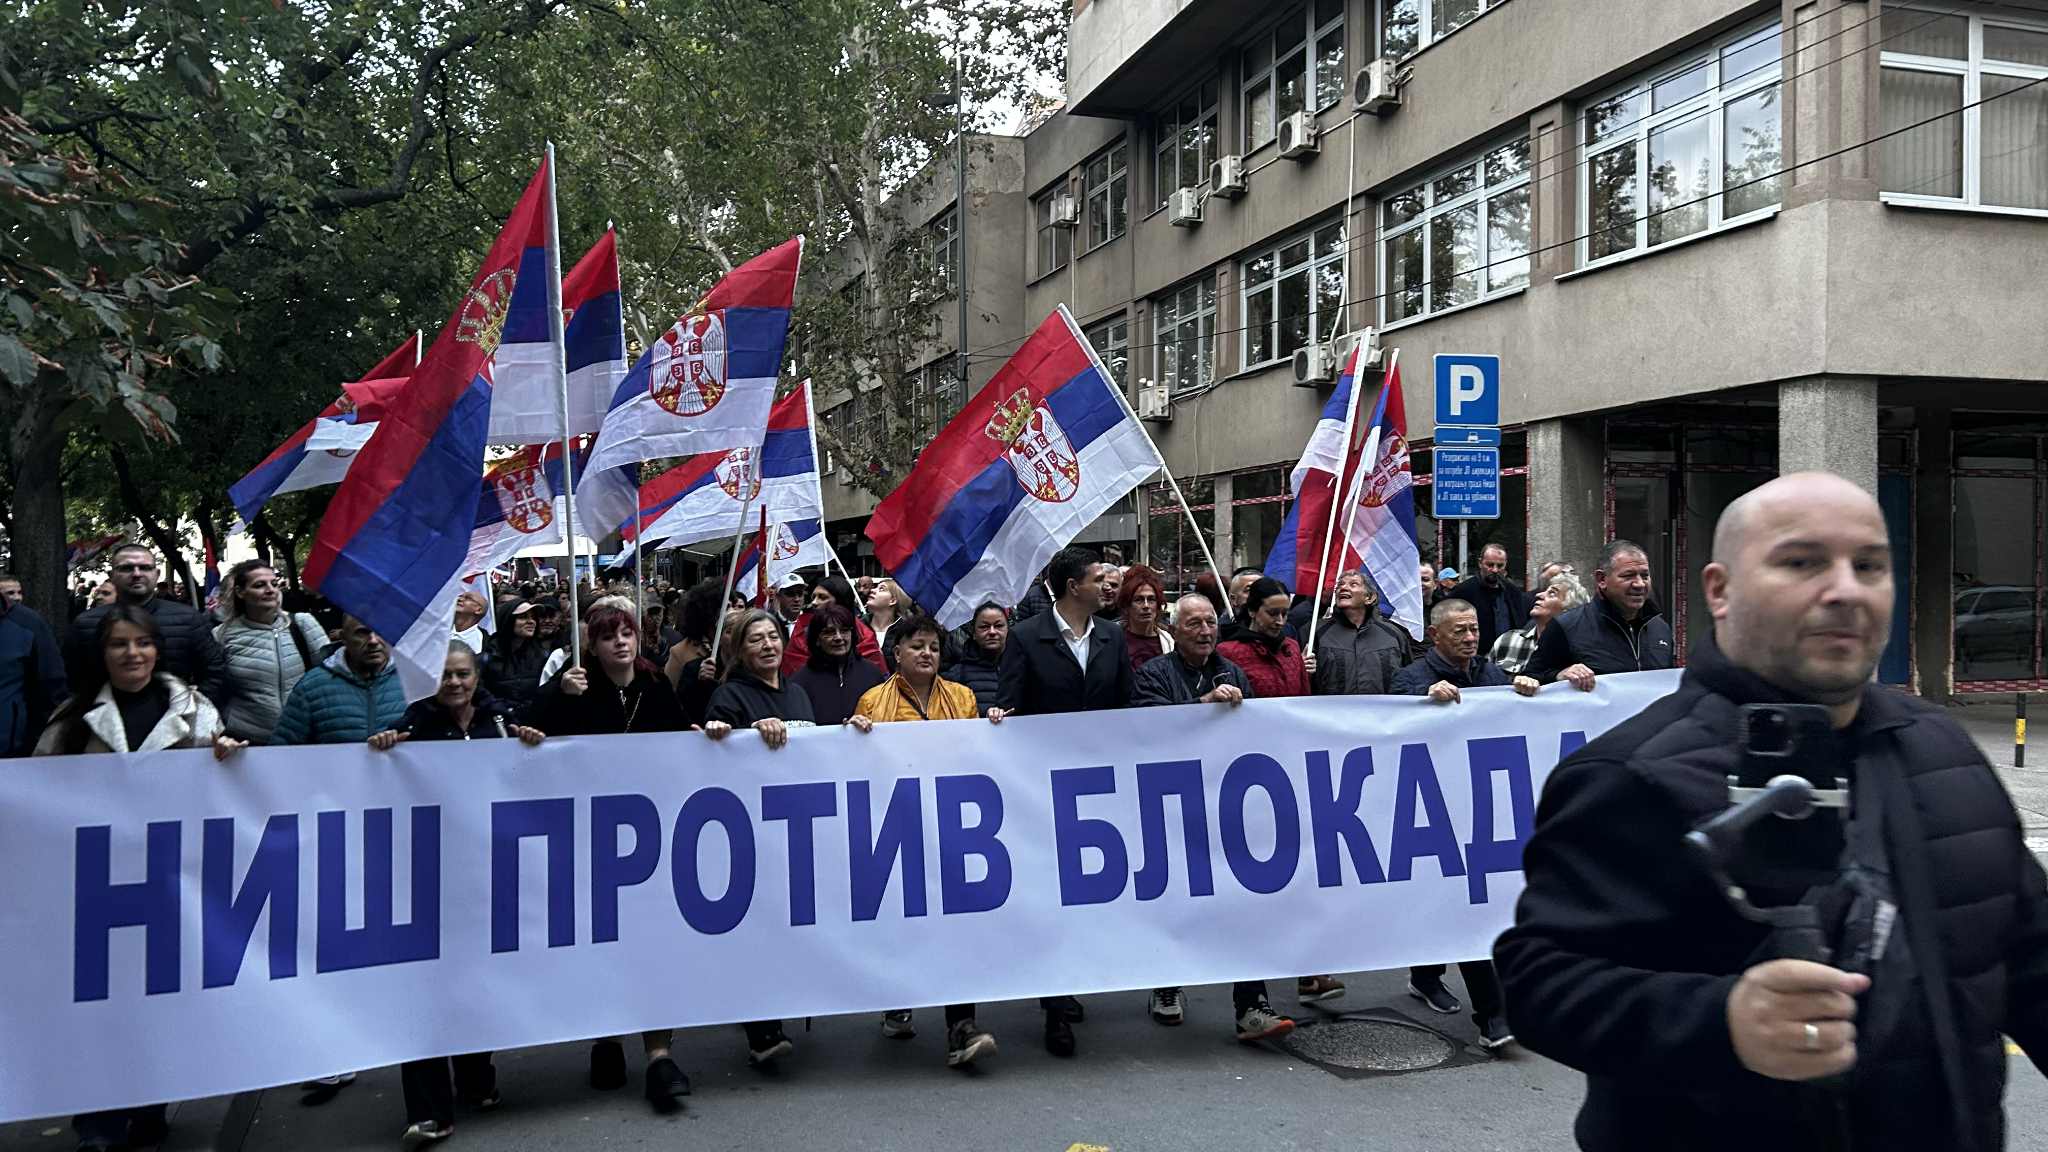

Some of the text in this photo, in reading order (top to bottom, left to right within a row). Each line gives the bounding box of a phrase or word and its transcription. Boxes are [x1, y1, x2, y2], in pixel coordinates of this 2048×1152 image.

[1450, 364, 1484, 416] P
[74, 730, 1587, 1003] НИШ ПРОТИВ БЛОКАД
